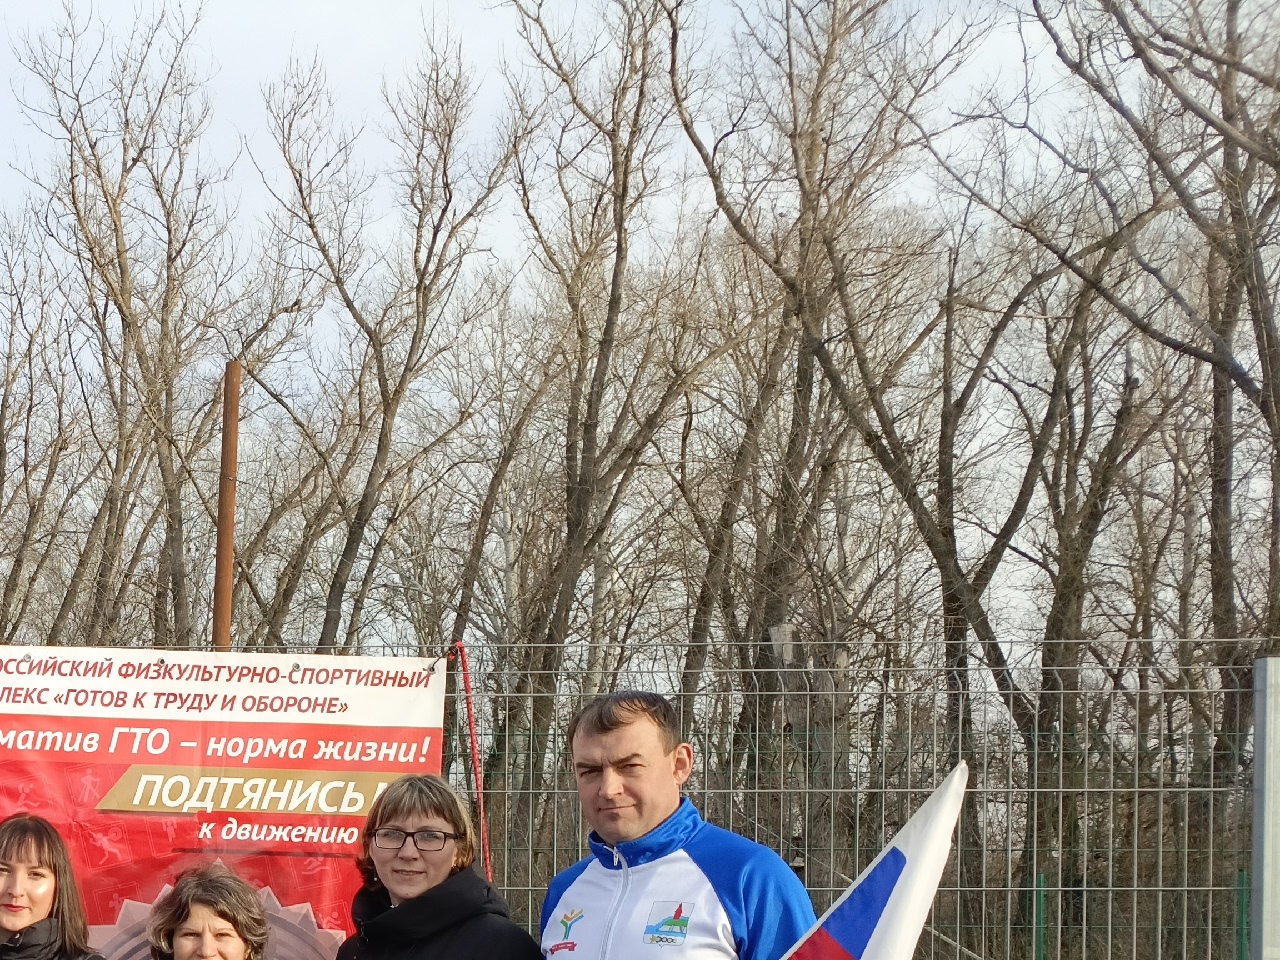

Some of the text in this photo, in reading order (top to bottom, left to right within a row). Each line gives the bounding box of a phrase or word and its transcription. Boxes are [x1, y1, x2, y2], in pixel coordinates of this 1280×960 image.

[117, 661, 431, 688] ФИЗКУЛЬТУРНО-СПОРТИВНЫЙ
[53, 688, 127, 708] «ГОТОВ
[132, 691, 148, 709] К
[154, 692, 217, 713] ТРУДУ
[220, 694, 236, 712] И
[241, 695, 350, 714] ОБОРОНЕ»
[108, 726, 170, 755] ГТО
[206, 736, 308, 764] норма
[313, 736, 432, 763] жизни!
[198, 816, 359, 845] к движению
